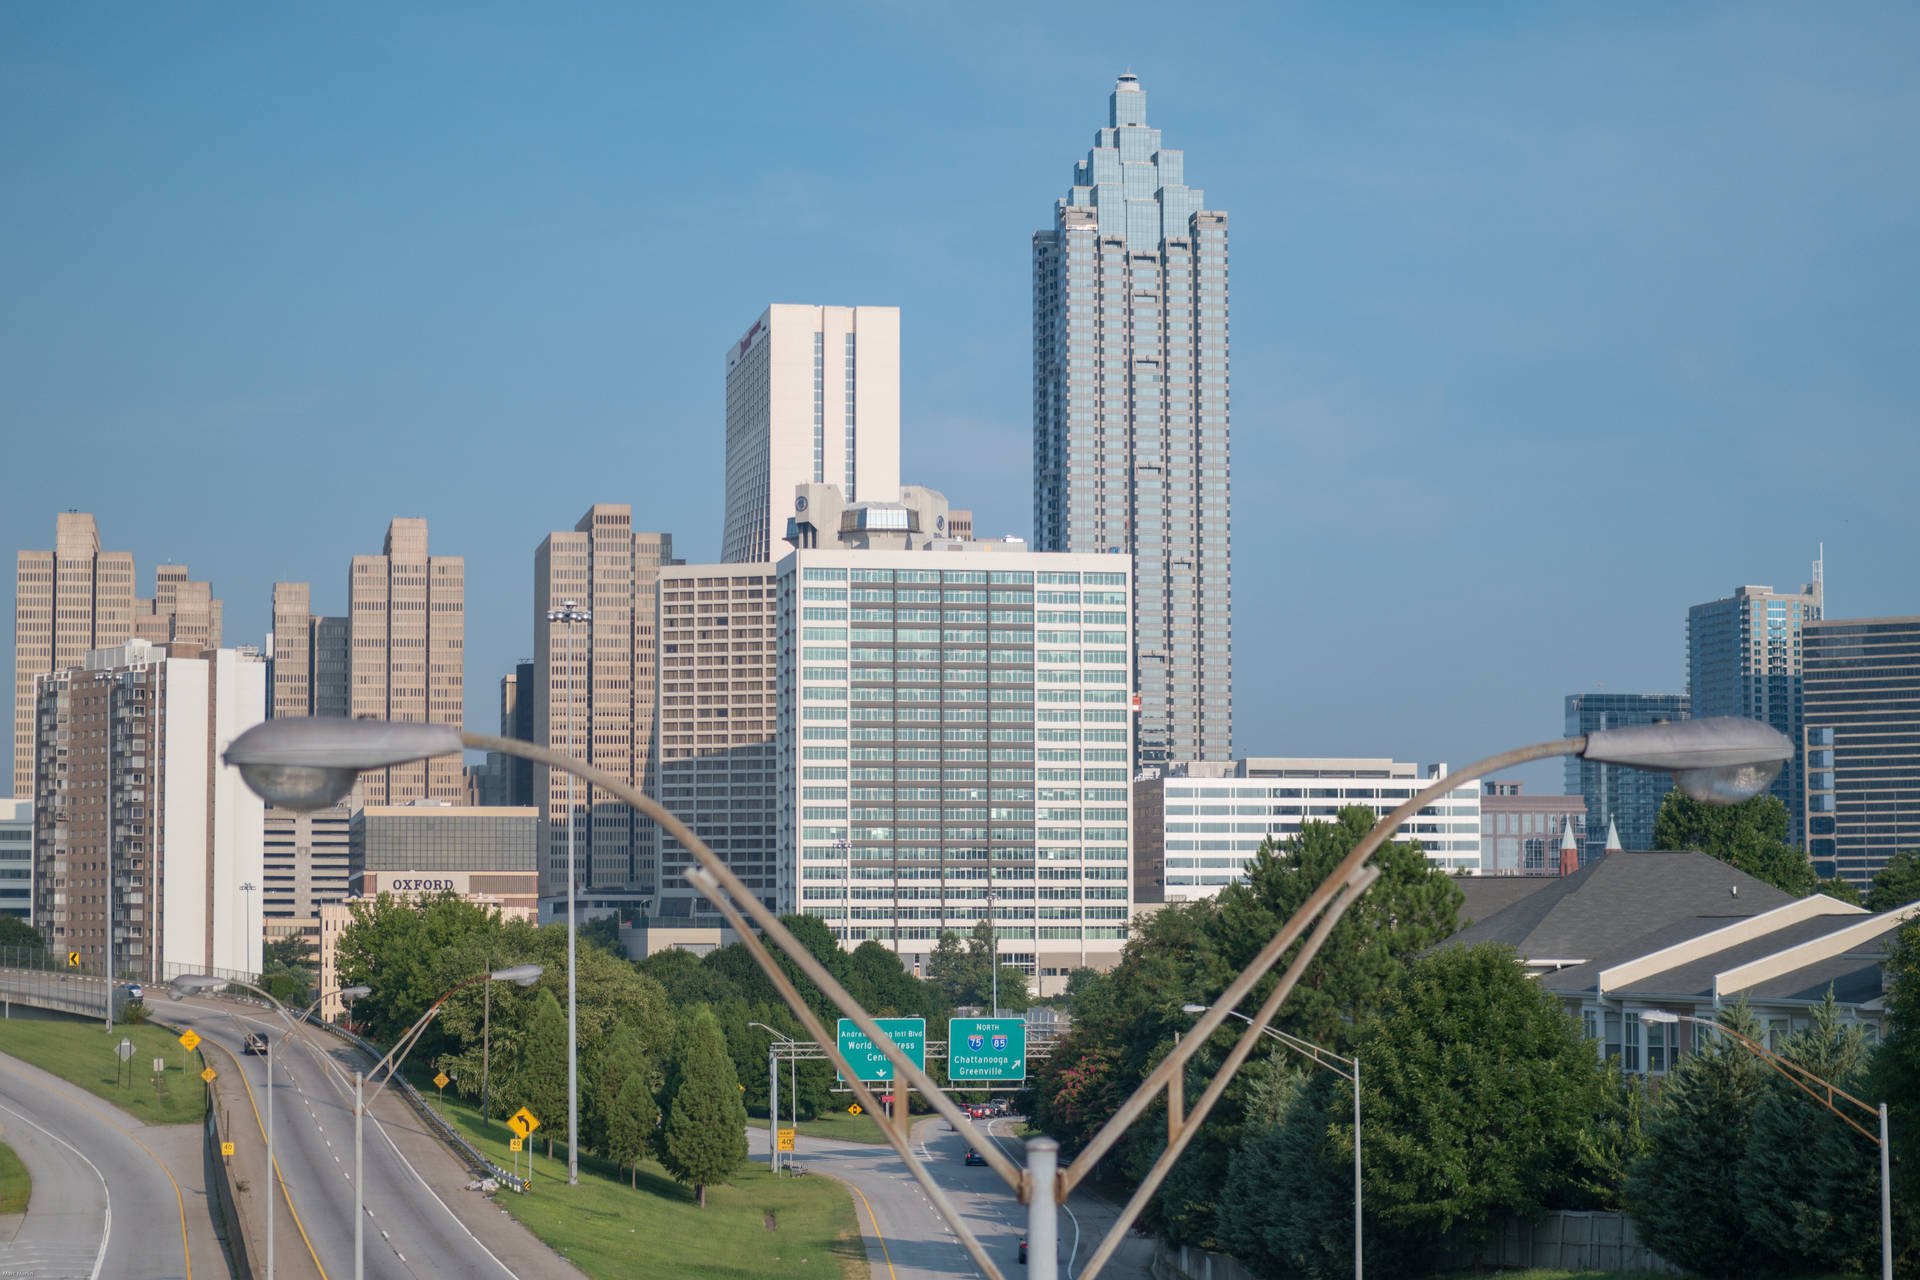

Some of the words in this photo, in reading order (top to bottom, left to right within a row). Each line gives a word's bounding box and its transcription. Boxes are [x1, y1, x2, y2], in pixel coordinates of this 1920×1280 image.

[392, 879, 454, 890] OXFORD
[976, 1023, 1000, 1031] NORTH
[848, 1041, 872, 1049] World
[971, 1039, 982, 1048] 75
[994, 1039, 1006, 1048] 85
[954, 1056, 1008, 1065] Chattanooga
[959, 1067, 1002, 1075] Greenville
